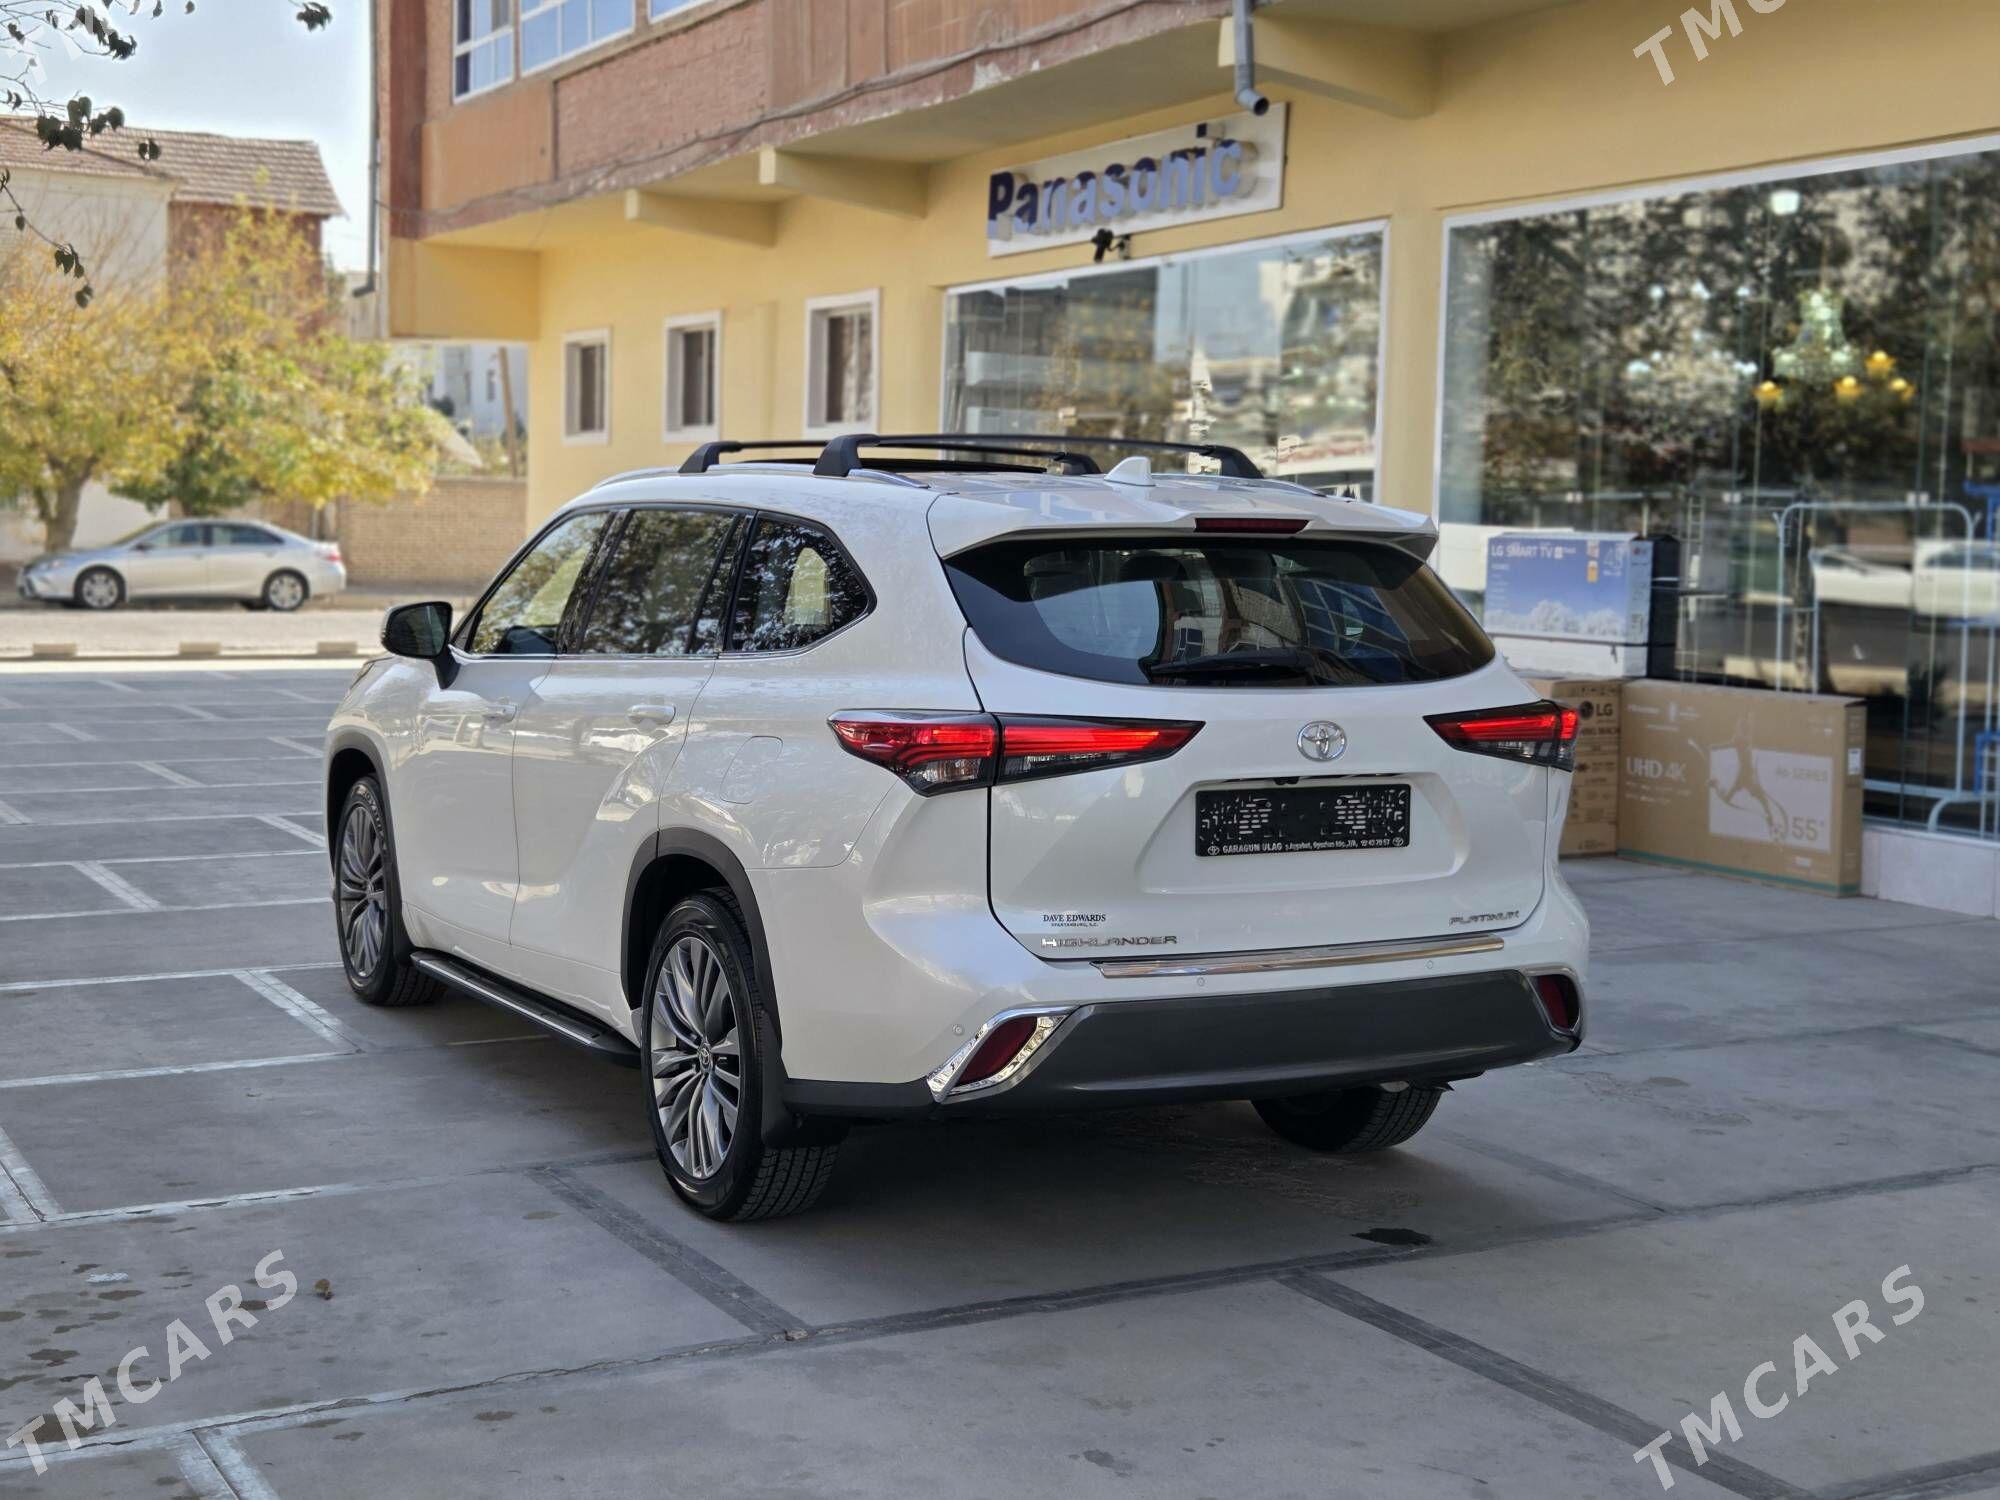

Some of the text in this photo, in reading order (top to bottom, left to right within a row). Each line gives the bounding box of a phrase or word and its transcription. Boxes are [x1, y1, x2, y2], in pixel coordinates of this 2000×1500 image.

[987, 123, 1243, 239] Panasonic
[1491, 546, 1504, 557] LG
[1506, 543, 1537, 557] SMART
[1540, 546, 1552, 558] TV
[1596, 703, 1613, 717] LG
[1626, 757, 1662, 779] UHD
[1665, 761, 1687, 782] 4K
[1043, 913, 1106, 922] DAVE EDWARDS
[1448, 910, 1519, 926] PLATINUM
[1041, 935, 1177, 949] HIGHLANDER
